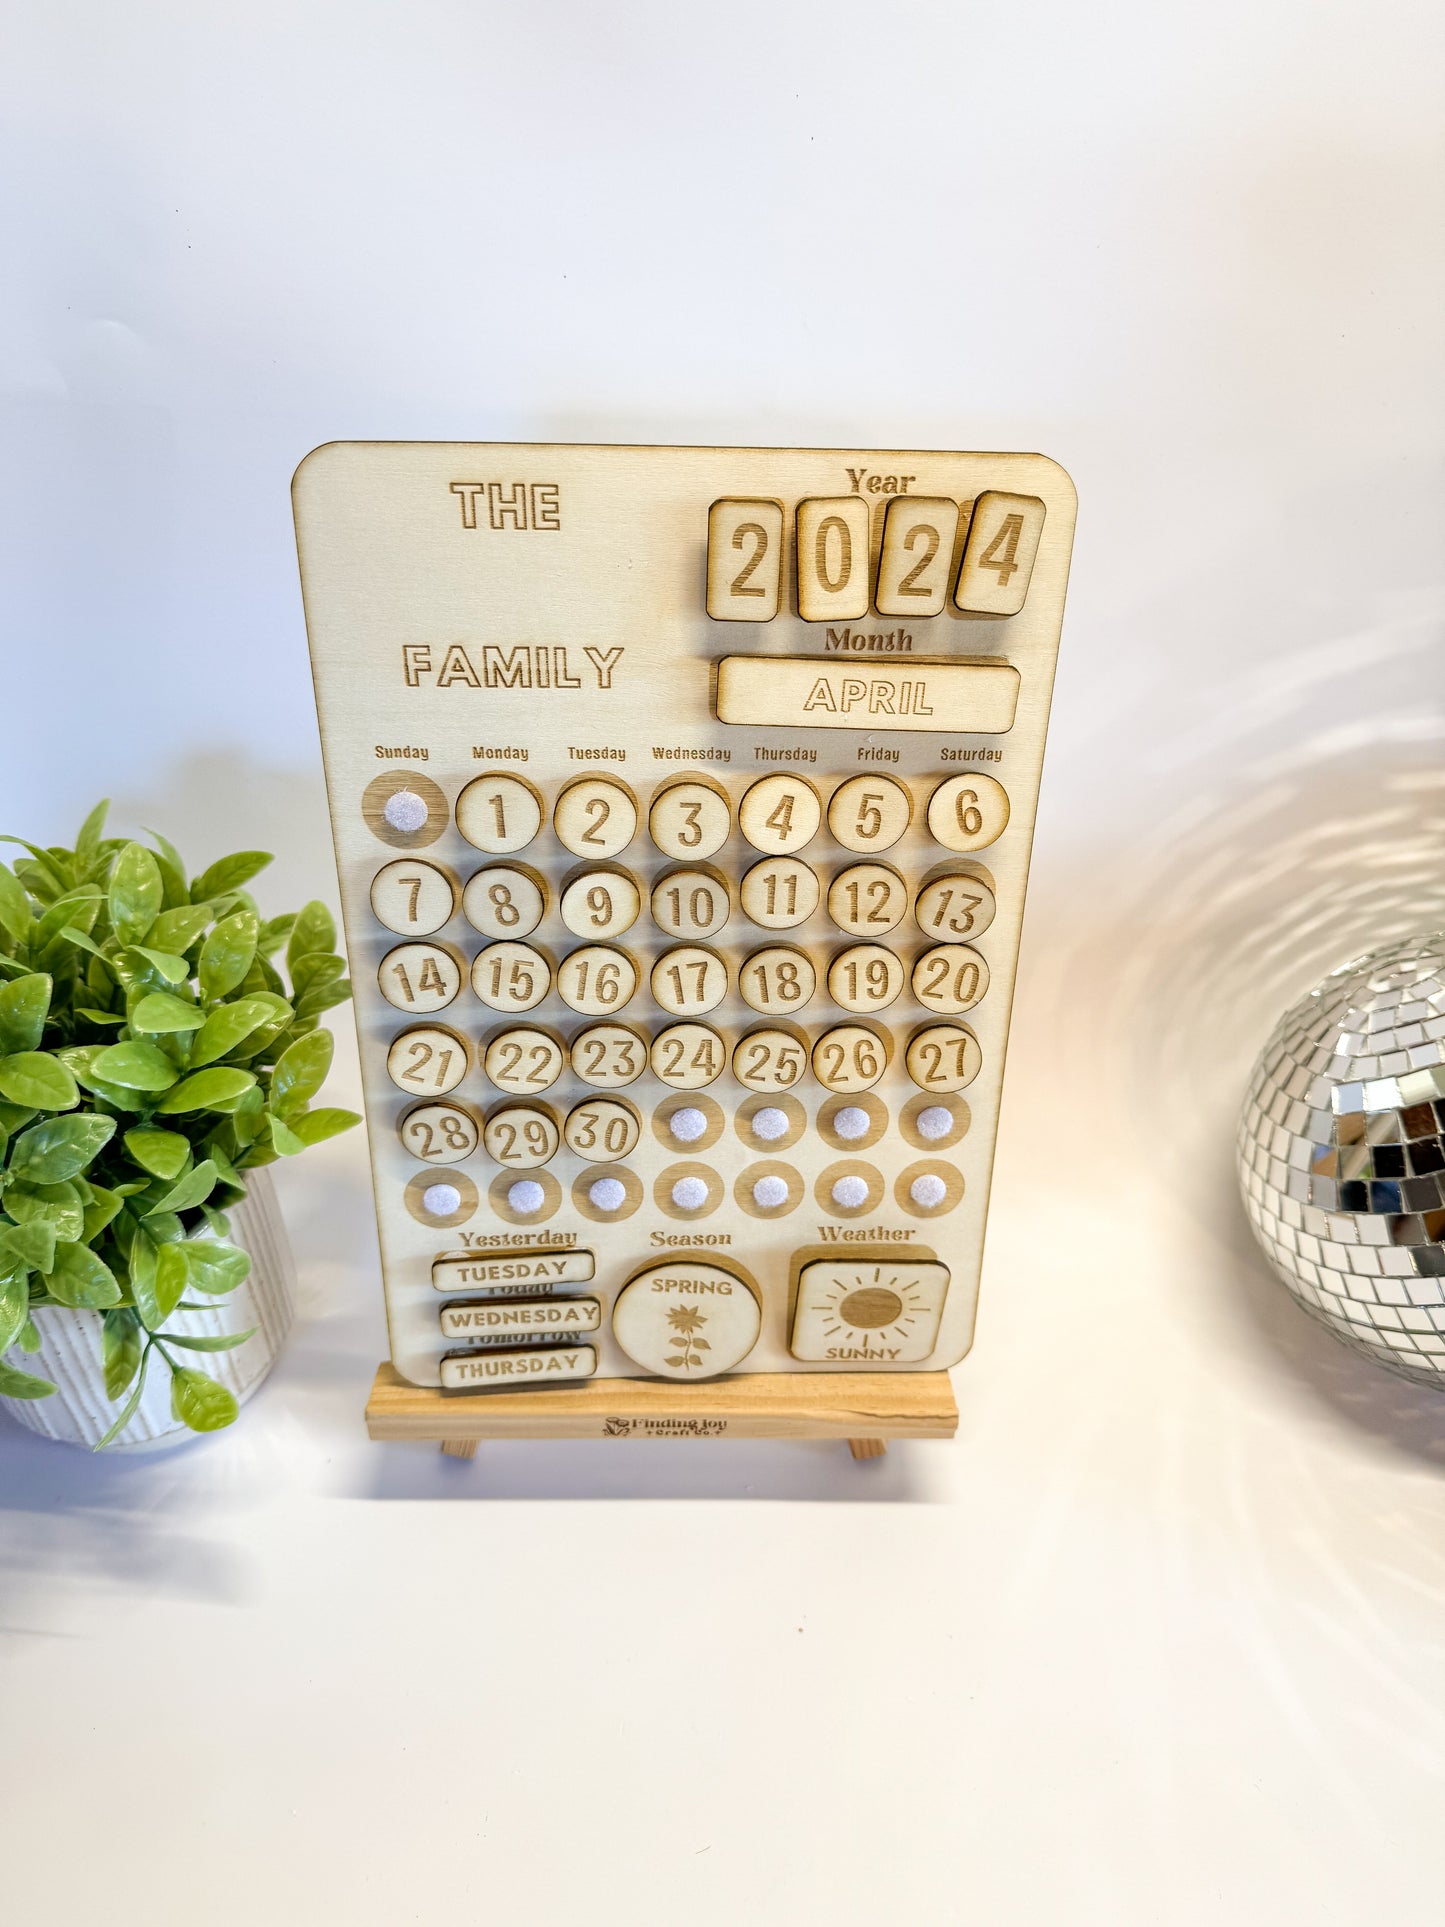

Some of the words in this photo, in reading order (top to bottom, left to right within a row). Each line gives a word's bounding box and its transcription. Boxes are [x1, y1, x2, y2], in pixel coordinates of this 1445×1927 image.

[845, 468, 916, 494] Year
[449, 482, 561, 531] THE
[825, 628, 913, 652] Month
[402, 644, 626, 689] FAMILY
[803, 677, 934, 716] APRIL
[375, 745, 429, 761] Sunday
[472, 746, 529, 761] Monday
[568, 746, 626, 761] Tuesday
[652, 747, 731, 762] Wednesday
[754, 747, 817, 762] Thursday
[857, 747, 900, 762] Friday
[940, 747, 1002, 763] Saturday
[488, 794, 506, 838] 1
[581, 798, 611, 846] 2
[678, 802, 702, 847] 3
[765, 794, 795, 841] 4
[855, 793, 884, 839] 5
[955, 789, 983, 836] 6
[398, 878, 422, 922] 7
[488, 884, 520, 927] 8
[586, 886, 613, 927] 9
[666, 887, 714, 928] 10
[763, 874, 798, 916] 11
[845, 880, 891, 924] 12
[931, 889, 983, 934] 13
[392, 957, 447, 1003] 14
[488, 956, 535, 1002] 15
[575, 960, 620, 1004] 16
[666, 961, 708, 1005] 17
[753, 961, 801, 1004] 18
[844, 959, 889, 1001] 19
[921, 957, 980, 1004] 20
[401, 1042, 453, 1088] 21
[496, 1042, 552, 1085] 22
[583, 1040, 635, 1077] 23
[662, 1038, 716, 1077] 24
[744, 1044, 800, 1085] 25
[822, 1039, 878, 1084] 26
[919, 1038, 967, 1084] 27
[410, 1116, 470, 1158] 28
[494, 1120, 549, 1160] 29
[573, 1112, 629, 1153] 30
[459, 1229, 578, 1247] Yesterday
[650, 1231, 732, 1247] Season
[817, 1225, 916, 1242] Weather
[457, 1260, 568, 1282] TUESDAY
[651, 1279, 733, 1296] SPRING
[450, 1306, 598, 1328] WEDNESDAY
[825, 1347, 902, 1360] SUNNY
[456, 1354, 579, 1379] THURSDAY
[631, 1418, 698, 1431] Finding
